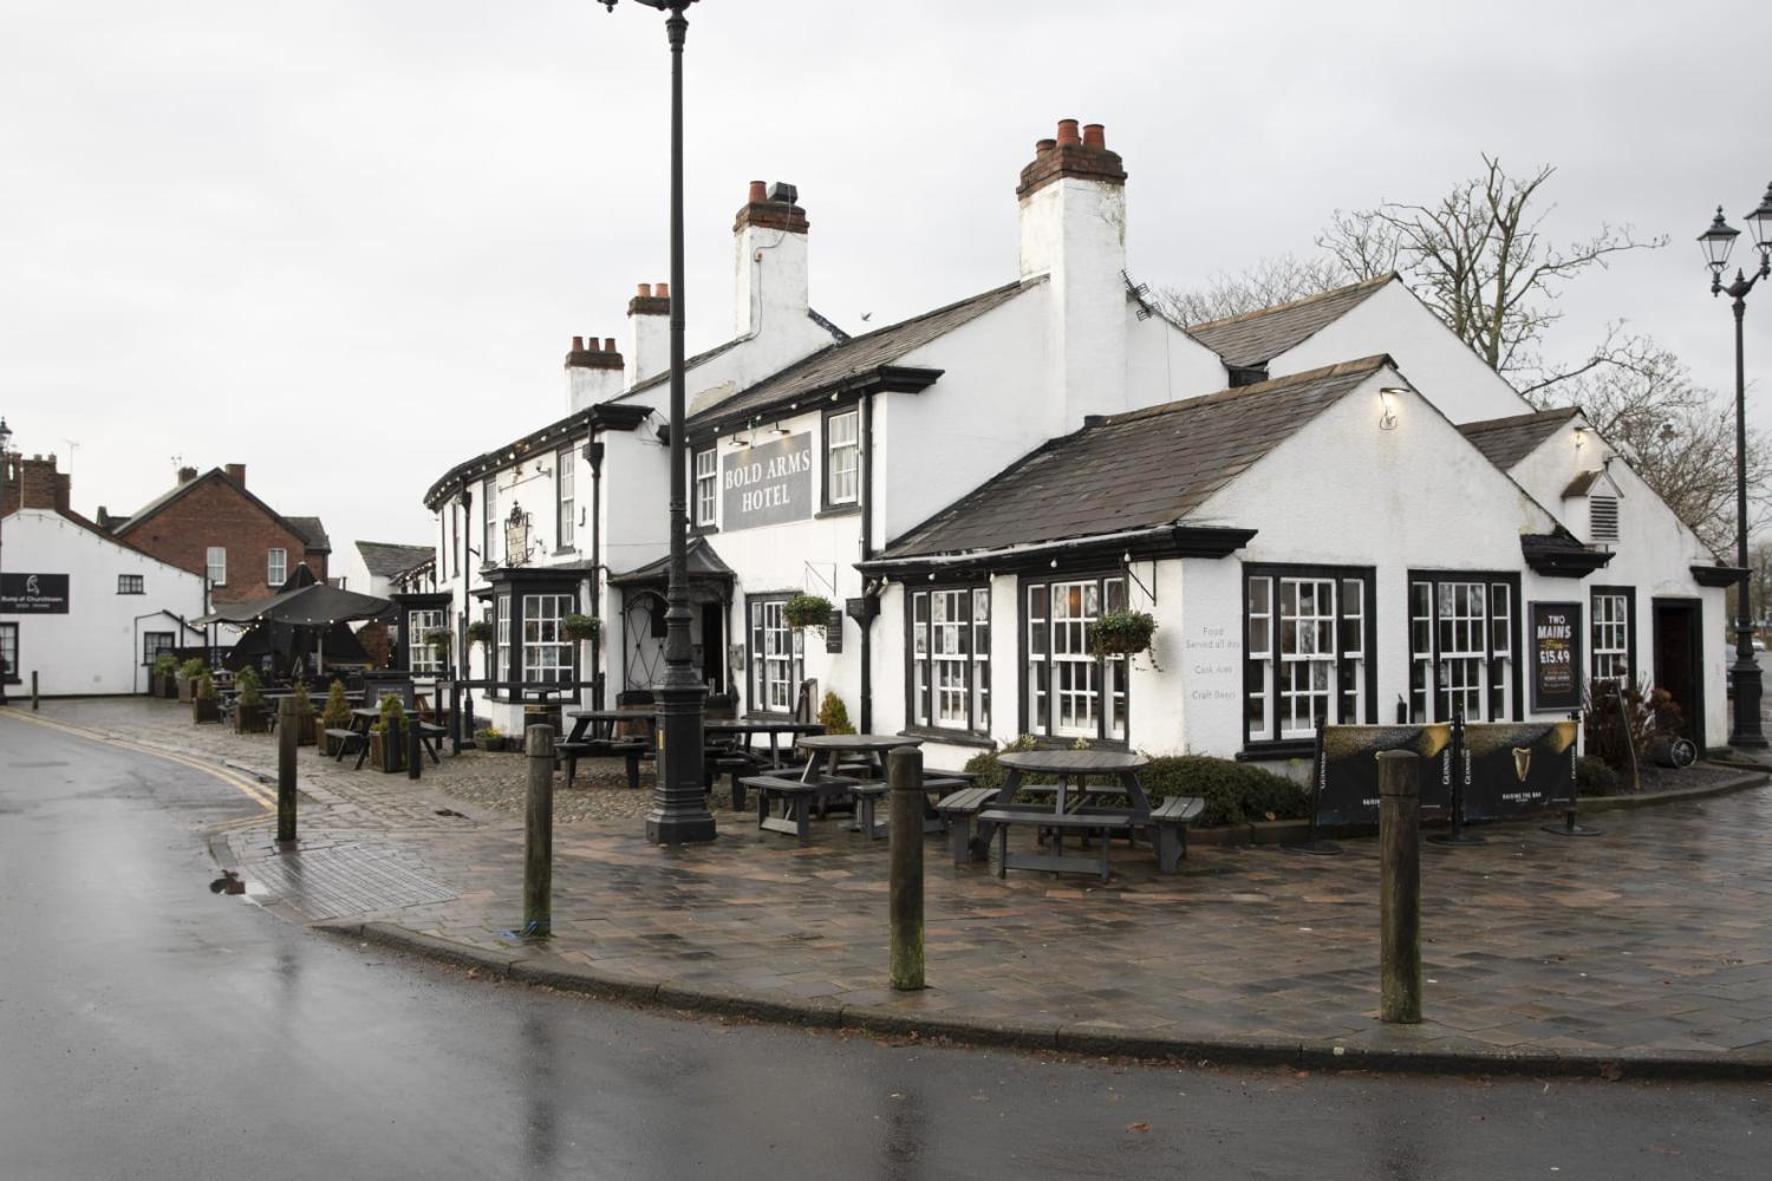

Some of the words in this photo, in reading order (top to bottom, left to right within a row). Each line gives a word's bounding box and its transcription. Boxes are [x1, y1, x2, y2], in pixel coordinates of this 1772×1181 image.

[725, 462, 762, 490] BOLD
[766, 449, 811, 479] ARMS
[742, 484, 791, 513] HOTEL
[1548, 615, 1566, 624] TWO
[1537, 625, 1572, 640] MAINS
[1540, 650, 1570, 664] £15.49
